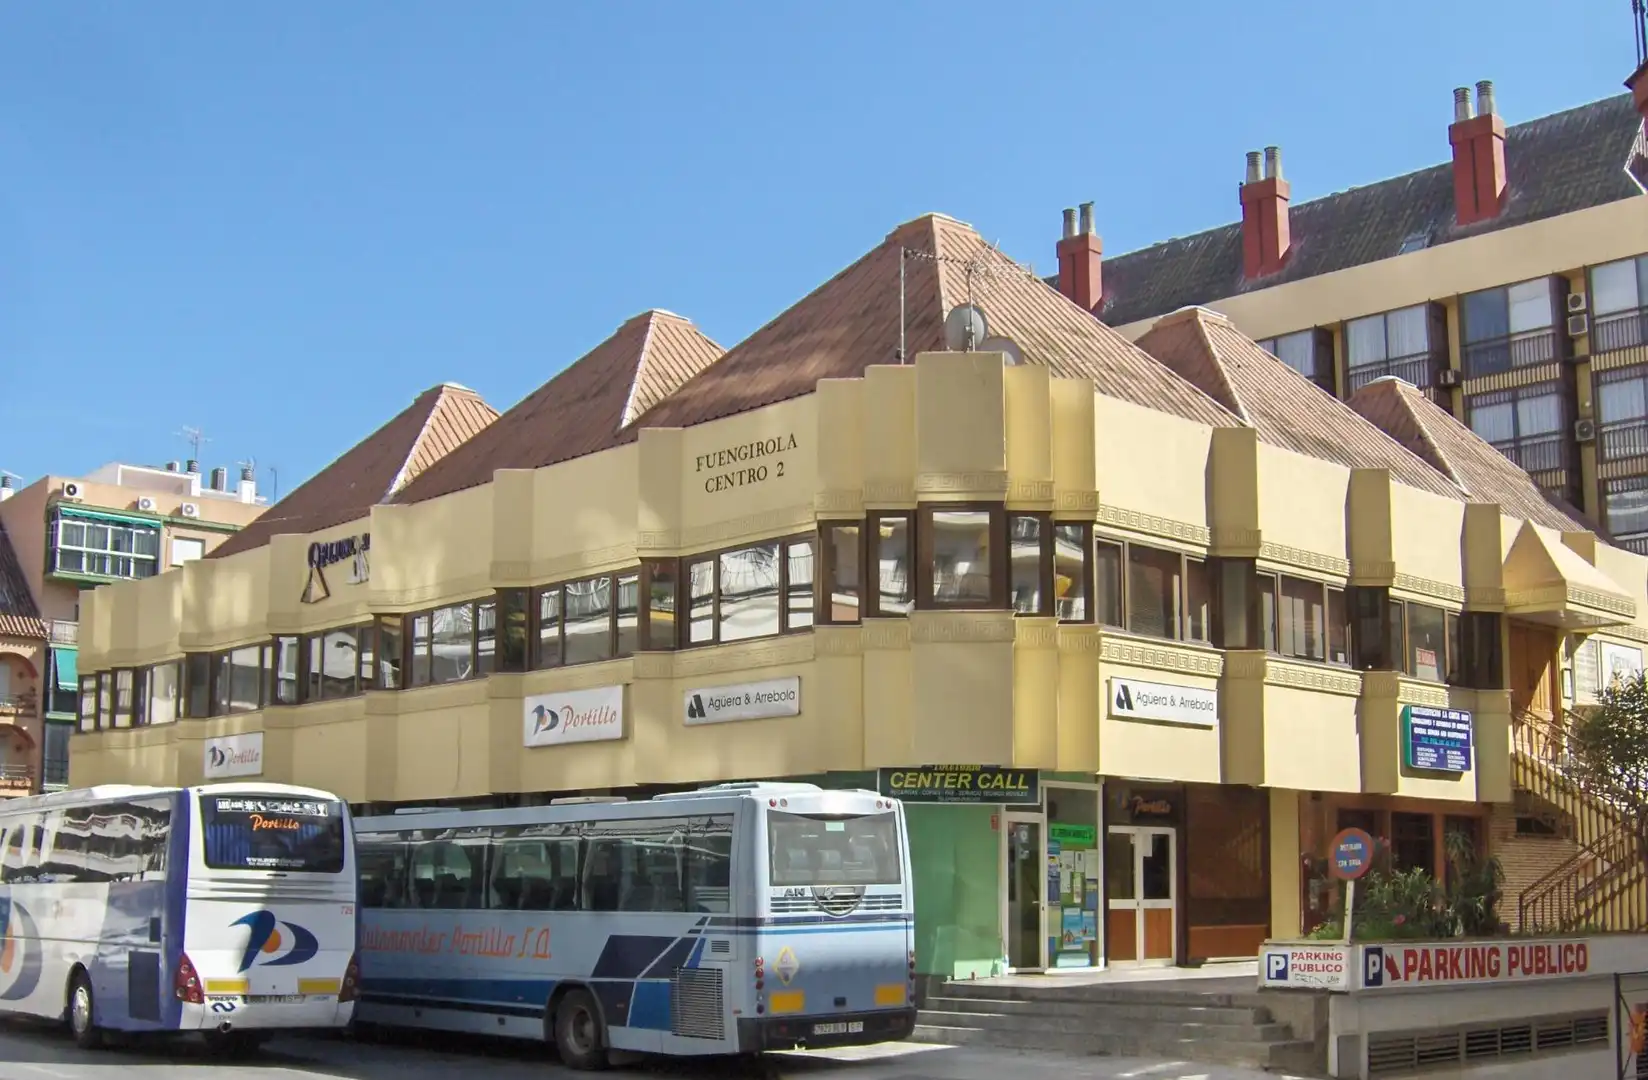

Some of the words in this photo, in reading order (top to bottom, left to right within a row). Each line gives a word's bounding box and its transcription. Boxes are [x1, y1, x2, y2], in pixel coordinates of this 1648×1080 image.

[696, 432, 798, 472] FUENGIROLA
[705, 465, 768, 494] CENTRO
[776, 460, 784, 477] 2
[744, 693, 751, 705] &
[754, 689, 796, 703] Arrebola
[1170, 695, 1176, 707] &
[1178, 696, 1214, 711] Arrebola
[560, 704, 617, 735] Portillo
[890, 772, 972, 788] CENTER
[977, 773, 1029, 789] CALL
[249, 814, 300, 831] Portillo
[1291, 952, 1343, 960] PARKING
[1404, 946, 1501, 981] PARKING
[1507, 943, 1588, 976] PUBLICO
[1291, 963, 1343, 973] PUBLICO
